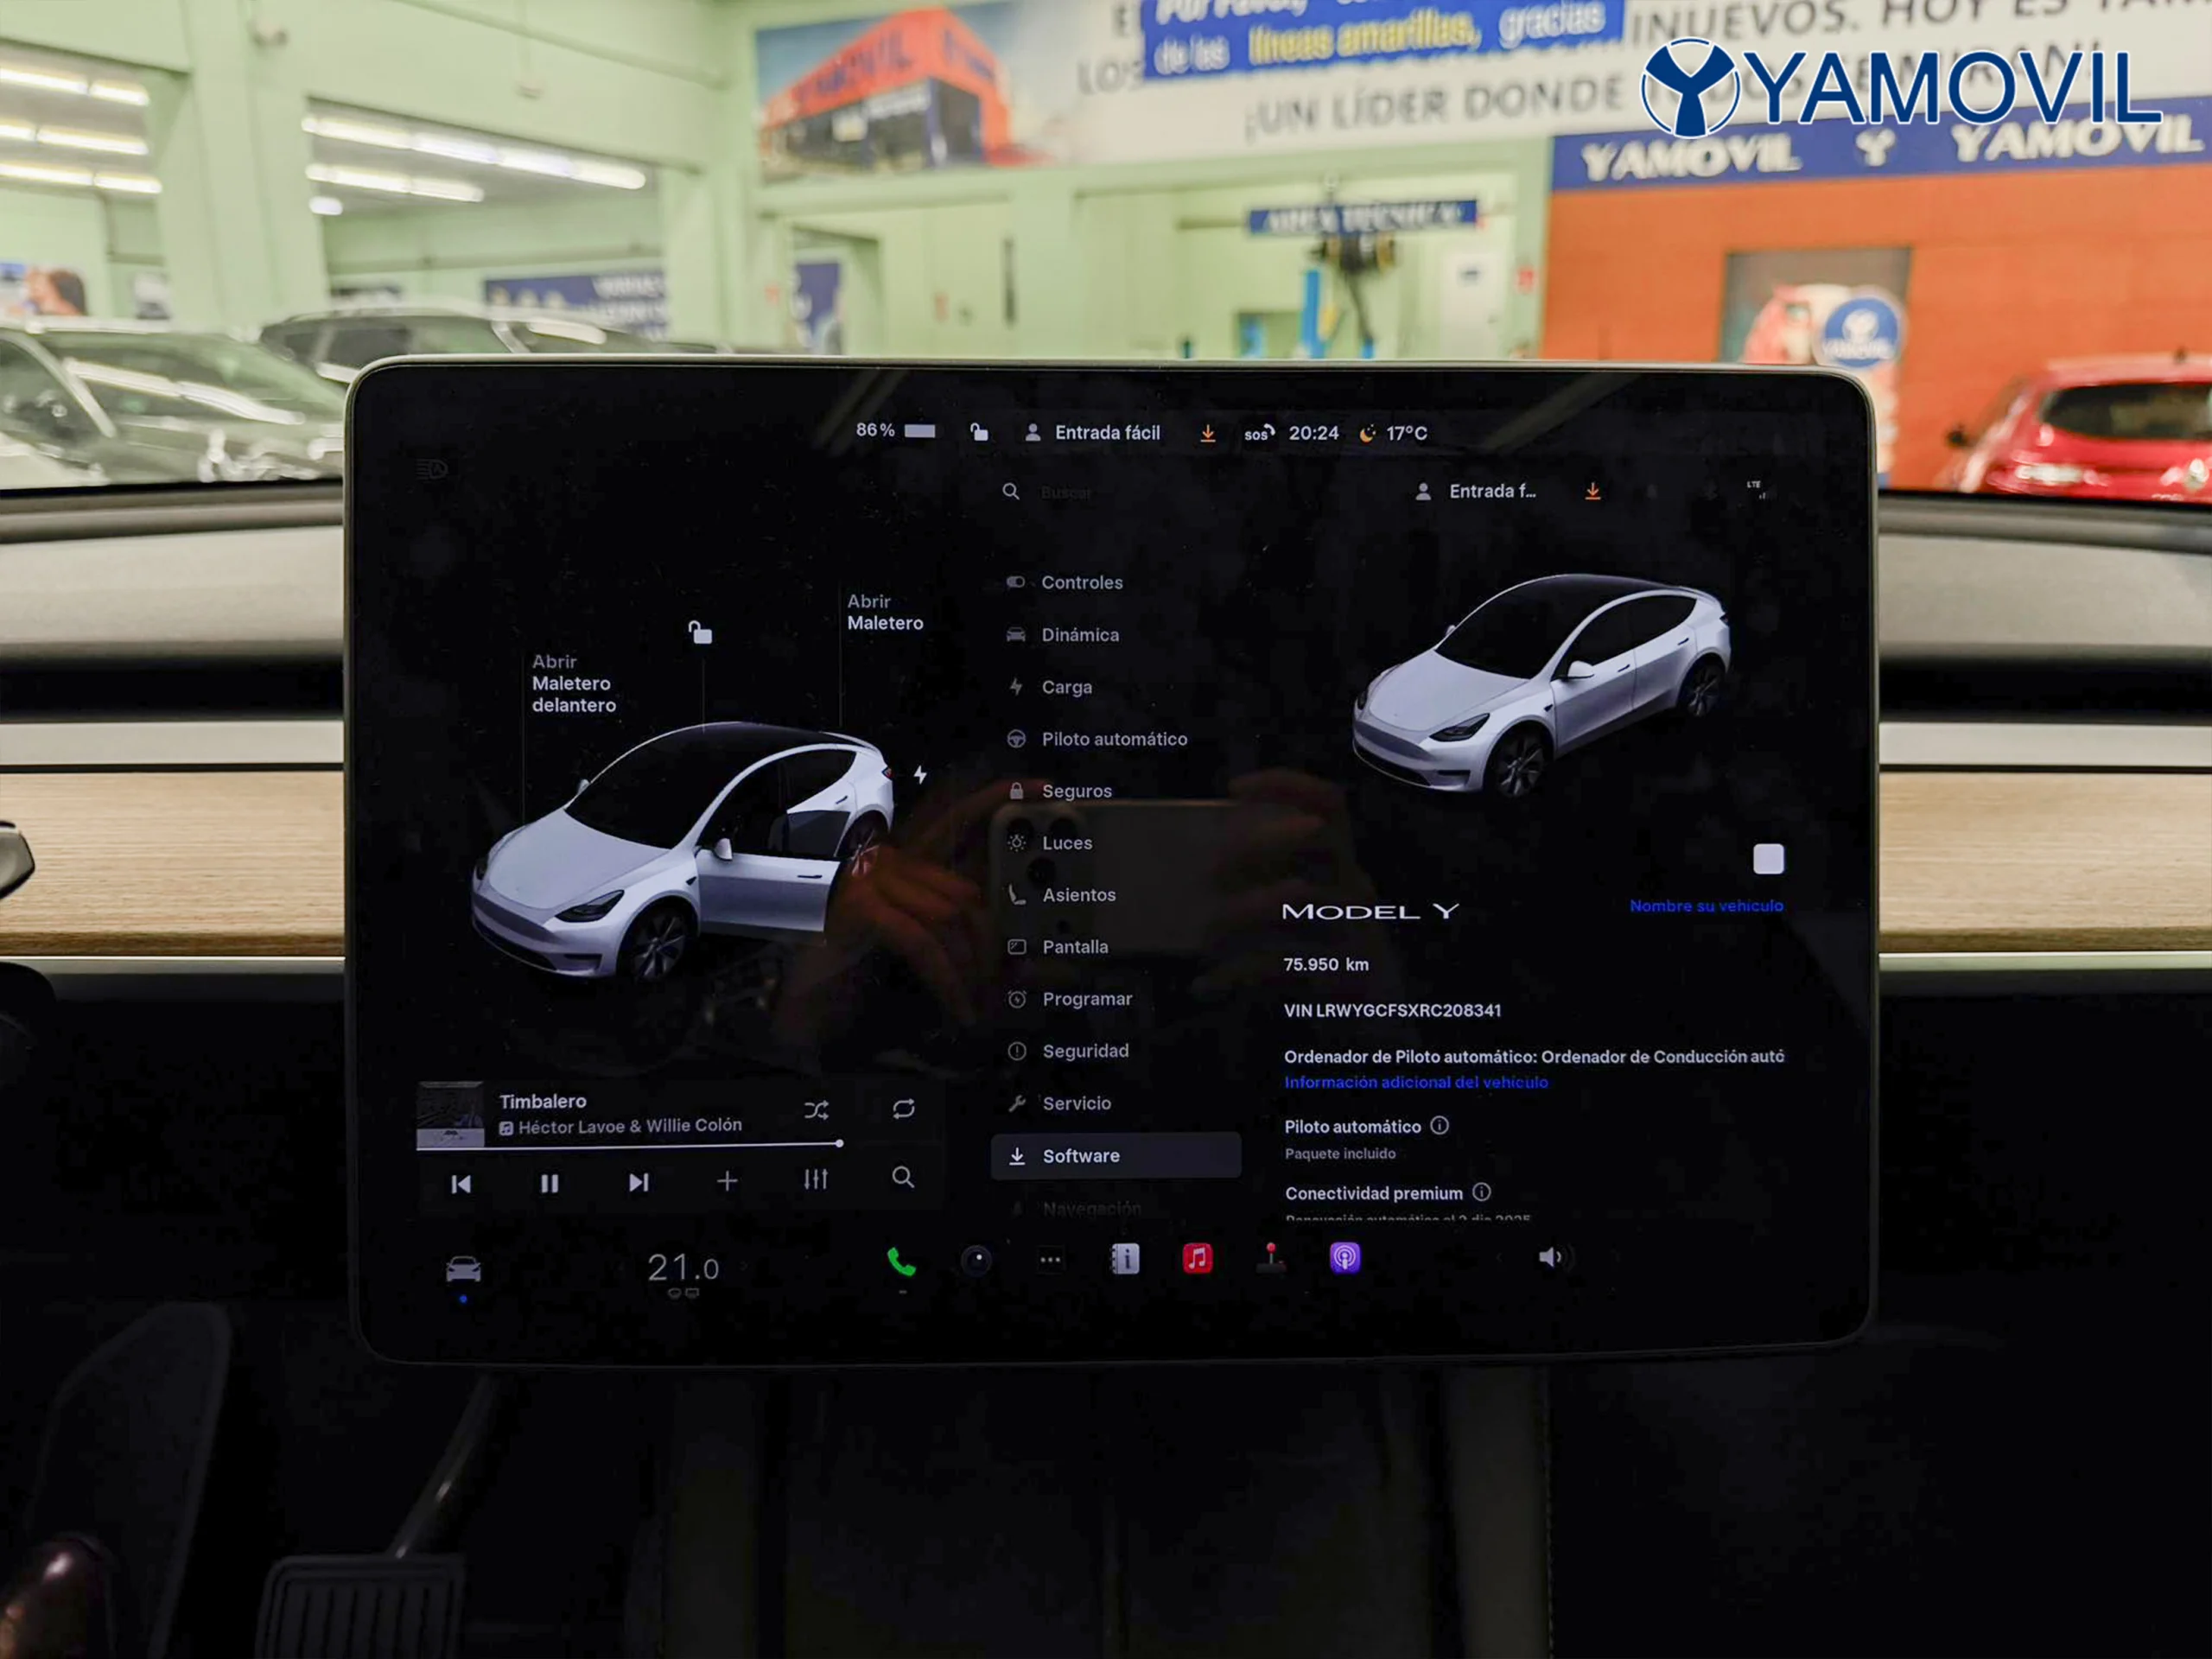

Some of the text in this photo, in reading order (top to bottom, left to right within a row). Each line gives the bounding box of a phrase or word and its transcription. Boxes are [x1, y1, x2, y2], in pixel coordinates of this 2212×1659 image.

[1498, 2, 1606, 48] gracias
[1465, 73, 1624, 120] DONDE
[1581, 134, 1803, 181] YAMOVIL
[1950, 112, 2205, 162] YAMOVIL
[1056, 424, 1160, 441] Entrada fácil
[1289, 425, 1339, 441] 20:24
[1386, 424, 1428, 442] 17°C
[1450, 483, 1515, 499] Entrada
[1041, 575, 1123, 590] Controles
[847, 594, 892, 609] Abrir
[848, 614, 925, 631] Maletero
[1042, 626, 1120, 642] Dinámica
[532, 654, 578, 669] Abrir
[532, 675, 611, 691] Maletero
[1042, 680, 1093, 698] Carga
[531, 696, 617, 713] delantero
[1042, 731, 1188, 747] Piloto automático
[1042, 784, 1113, 802] Seguros
[1043, 836, 1093, 850] Luces
[1043, 887, 1116, 903] Asientos
[1282, 903, 1459, 920] MODEL Y
[1630, 899, 1694, 912] Nombre
[1697, 902, 1716, 913] su
[1043, 938, 1109, 955] Pantalla
[1283, 957, 1370, 972] 75.950 km
[1043, 991, 1134, 1010] Programar
[1284, 1003, 1501, 1018] VIN LRWYGCFSXRC208341
[1043, 1042, 1129, 1062] Seguridad
[1284, 1049, 1370, 1064] Ordenador
[1371, 1049, 1392, 1064] de
[1395, 1049, 1441, 1064] Piloto
[1443, 1049, 1538, 1064] automático:
[1541, 1049, 1627, 1064] Ordenador
[1630, 1049, 1651, 1064] de
[1653, 1049, 1748, 1064] Conducción
[1285, 1076, 1379, 1090] Información
[1382, 1076, 1452, 1090] adicional
[1454, 1076, 1480, 1090] del
[499, 1093, 588, 1109] Timbalero
[1043, 1095, 1112, 1111] Servicio
[518, 1116, 742, 1135] Héctor Lavoe & Willie Colón
[1285, 1119, 1422, 1135] Piloto automático
[1043, 1147, 1121, 1164] Software
[1285, 1147, 1396, 1162] Paquete incluido
[1285, 1185, 1464, 1204] Conectividad premium
[648, 1253, 720, 1281] 21.0
